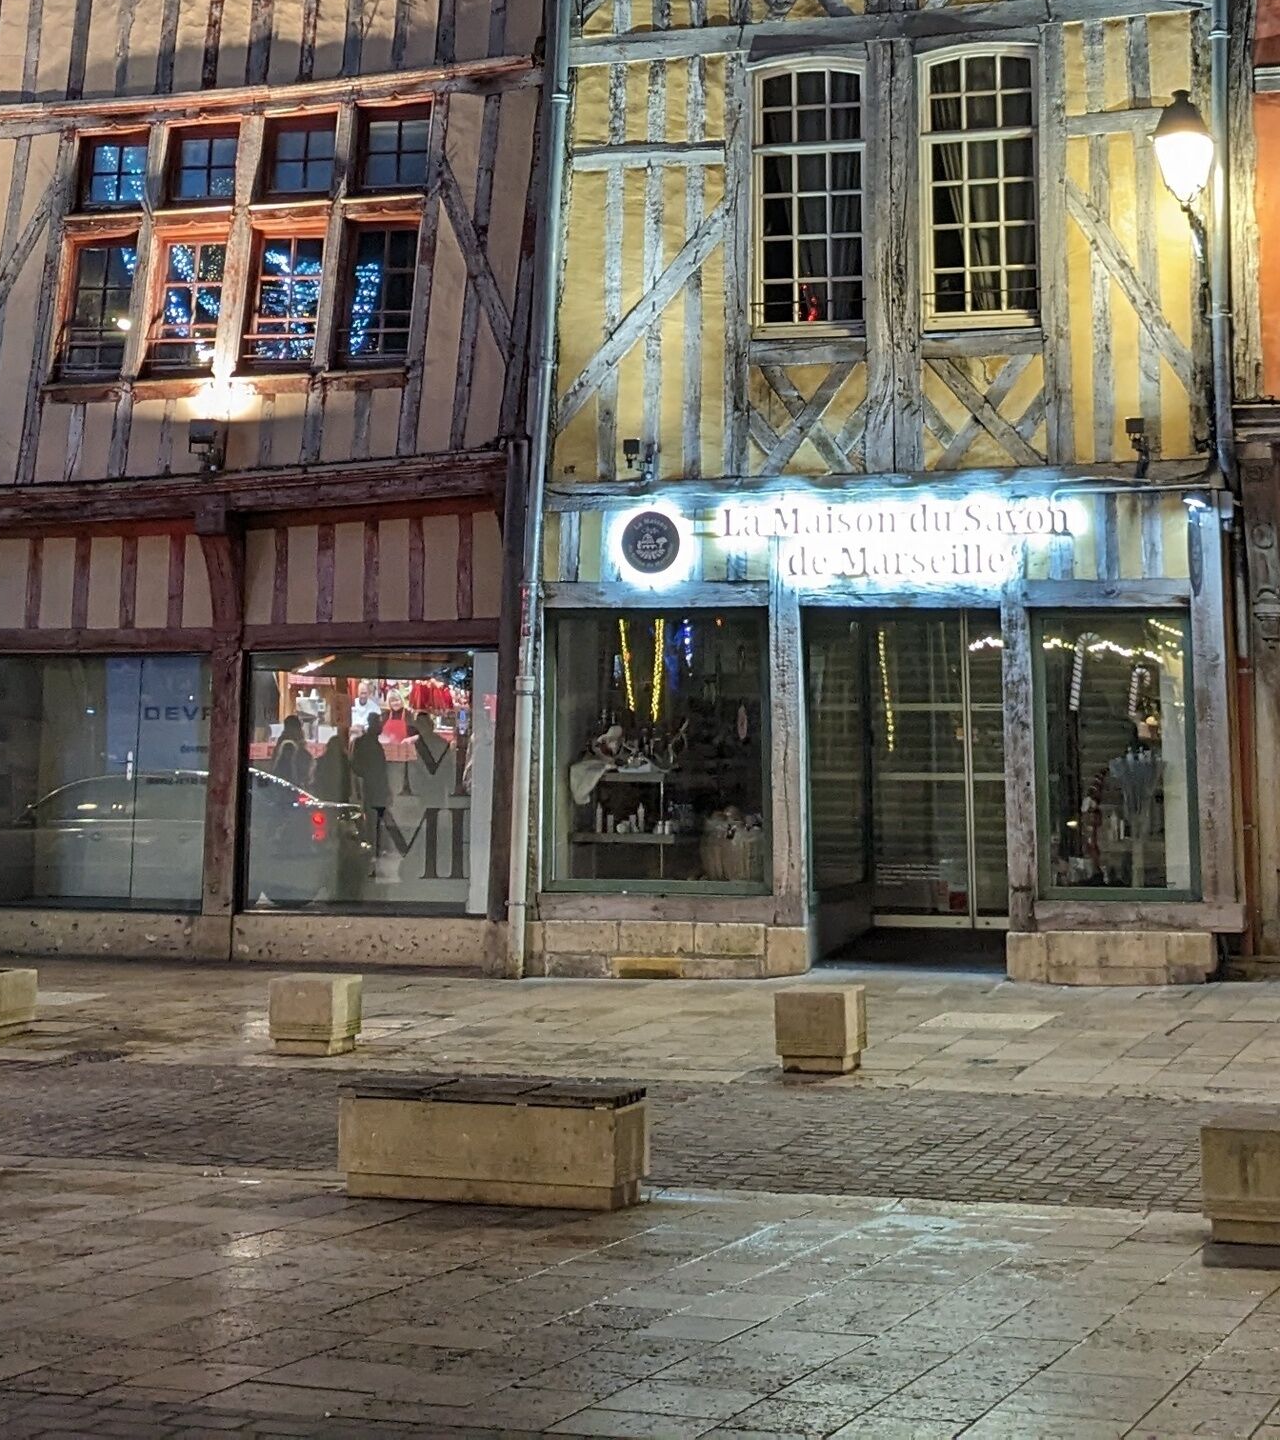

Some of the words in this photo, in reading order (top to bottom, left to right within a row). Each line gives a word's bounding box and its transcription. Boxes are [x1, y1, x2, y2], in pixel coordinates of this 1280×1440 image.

[723, 508, 760, 537] La
[774, 505, 896, 535] Maison
[909, 503, 951, 533] du
[964, 503, 1070, 534] Savon
[788, 546, 827, 577] de
[841, 543, 1005, 576] Marseille
